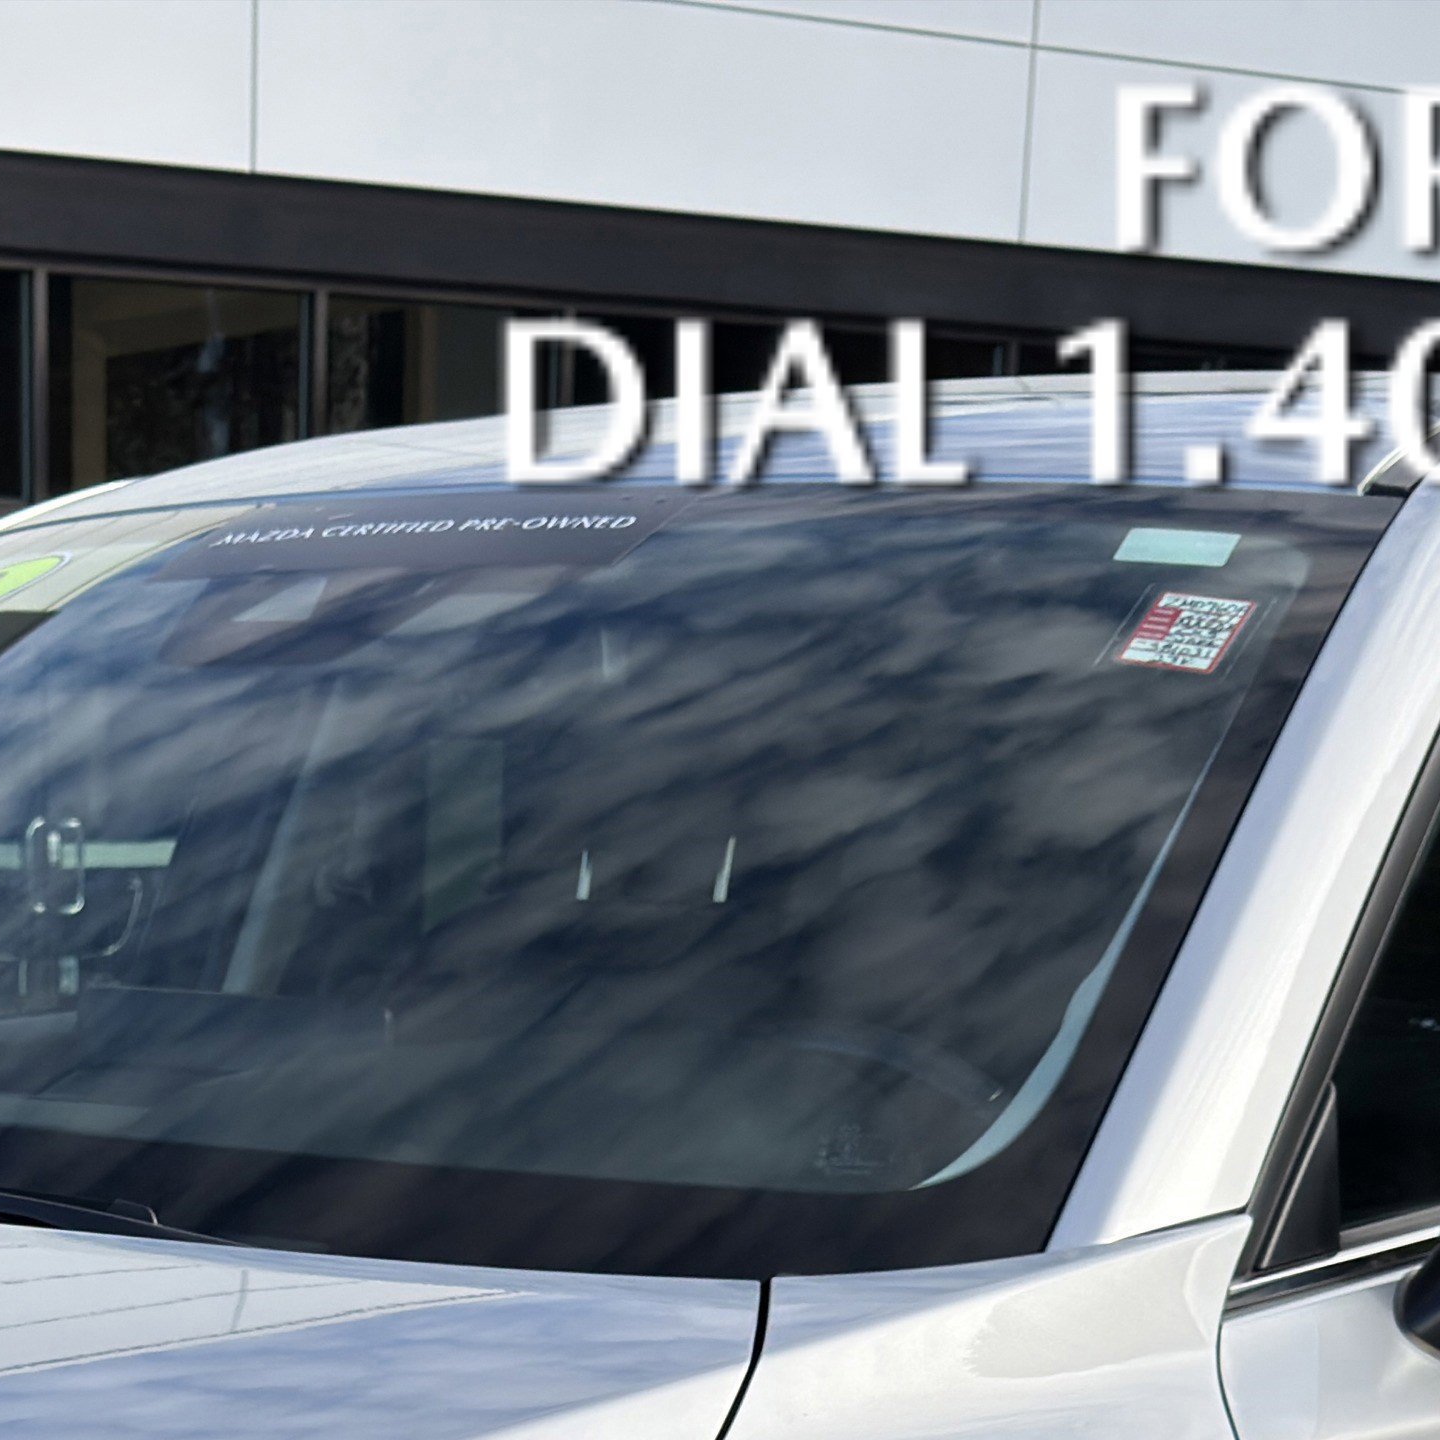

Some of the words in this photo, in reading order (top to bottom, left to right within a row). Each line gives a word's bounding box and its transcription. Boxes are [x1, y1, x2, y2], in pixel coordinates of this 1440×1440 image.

[209, 526, 315, 548] MAZDA
[321, 518, 456, 540] CERTIFIED
[457, 514, 638, 533] PRE-OWNED
